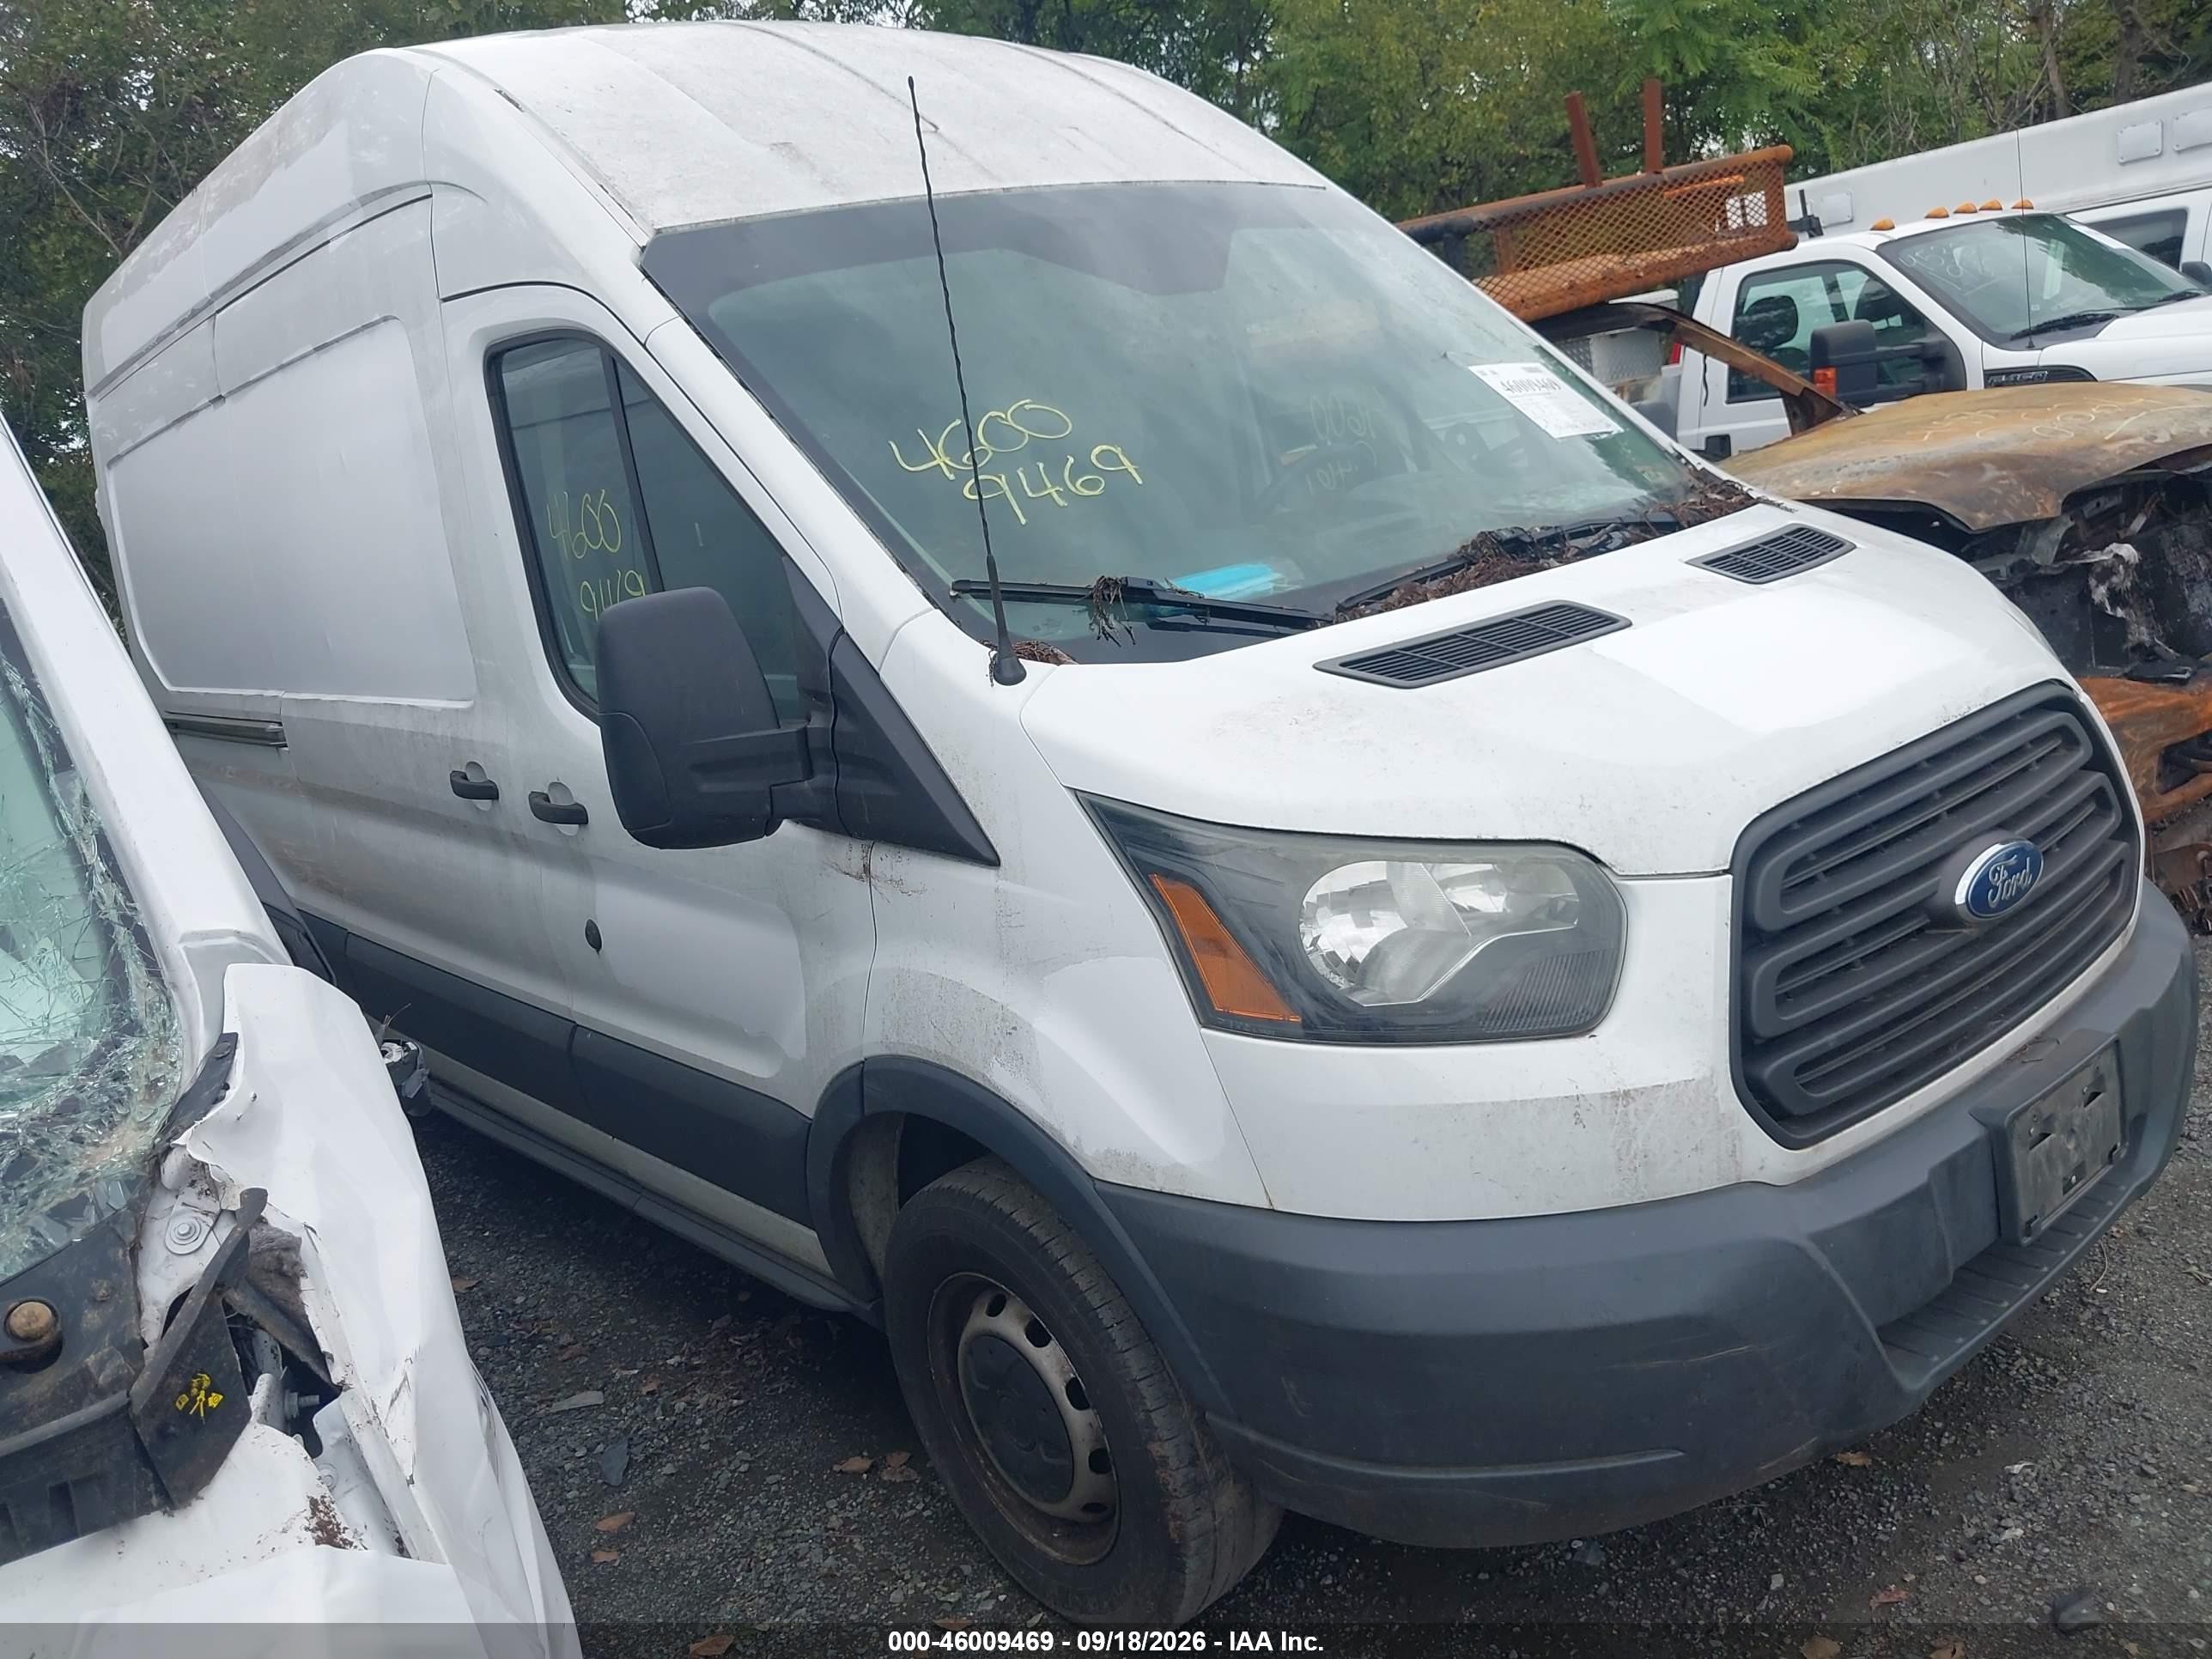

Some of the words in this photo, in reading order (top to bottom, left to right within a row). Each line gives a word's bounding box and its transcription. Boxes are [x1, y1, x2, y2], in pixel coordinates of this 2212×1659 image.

[888, 398, 1073, 481] 4600
[962, 444, 1143, 526] 9469
[546, 489, 622, 562] 4600
[1988, 854, 2033, 908] Ford
